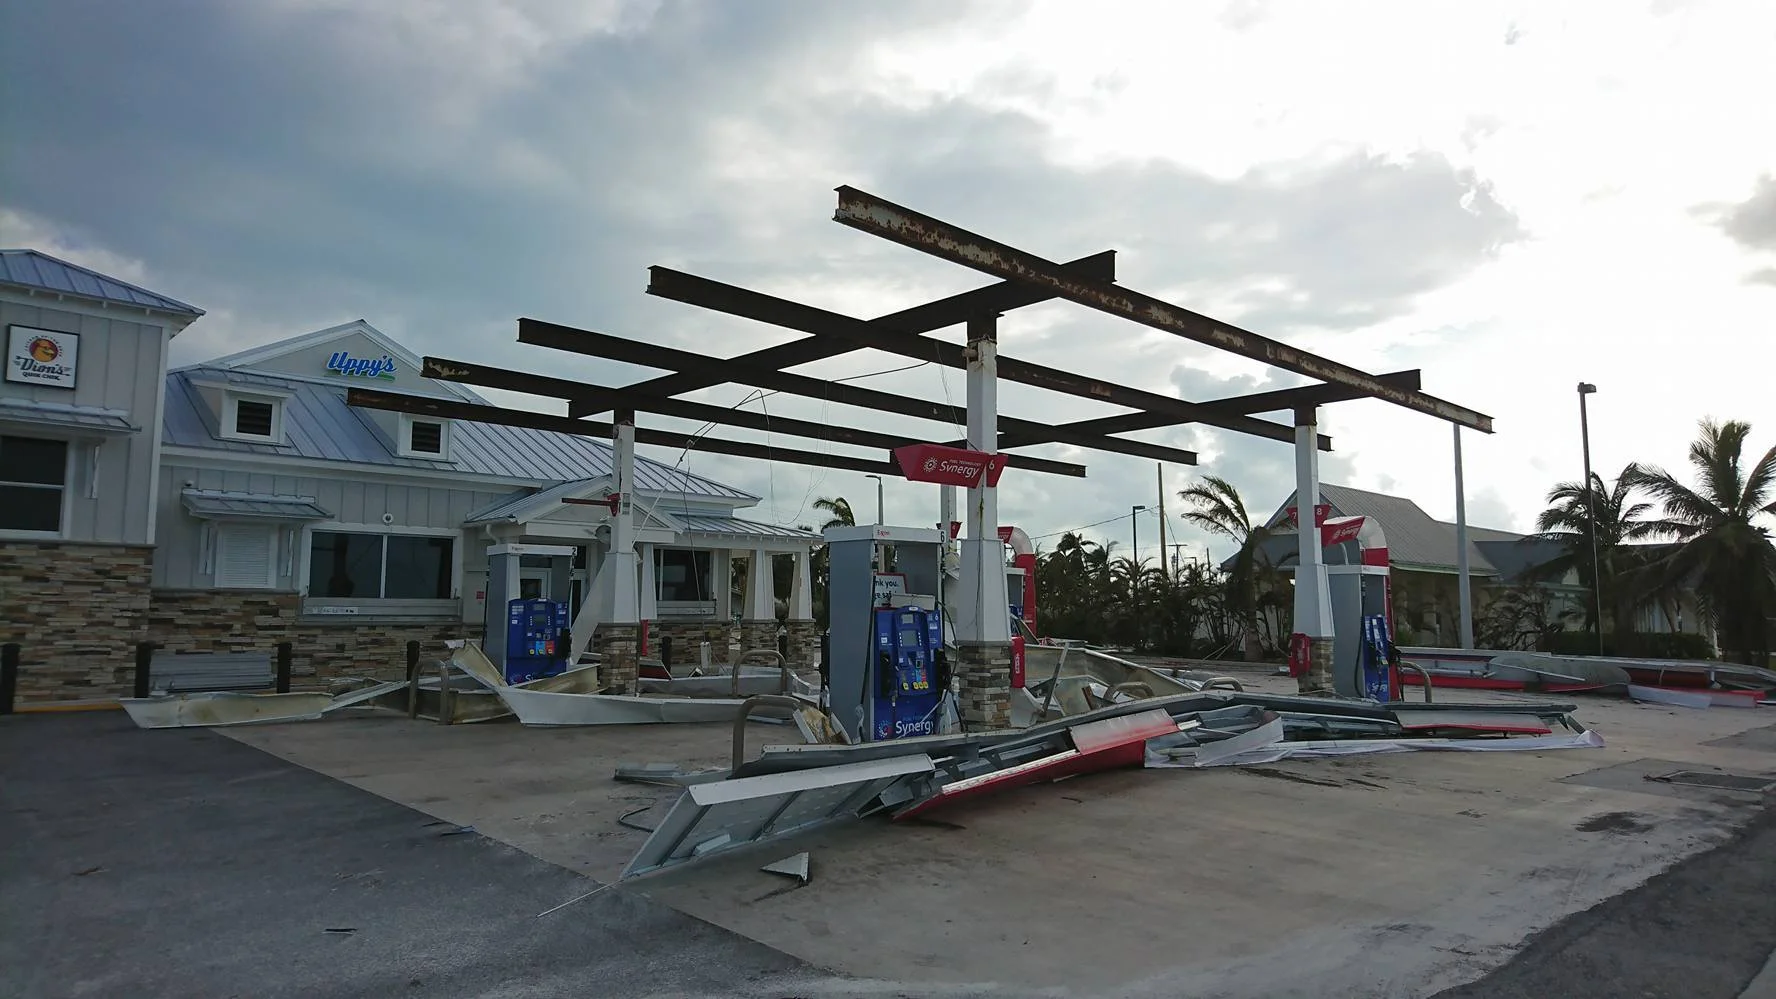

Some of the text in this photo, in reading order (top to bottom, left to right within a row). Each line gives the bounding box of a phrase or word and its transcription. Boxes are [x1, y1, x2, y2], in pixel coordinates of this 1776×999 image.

[18, 357, 66, 375] Dion's
[328, 351, 397, 377] Uppy's
[939, 461, 979, 478] Synergy
[989, 460, 995, 470] 6
[1317, 507, 1322, 516] 8
[941, 530, 946, 543] 6
